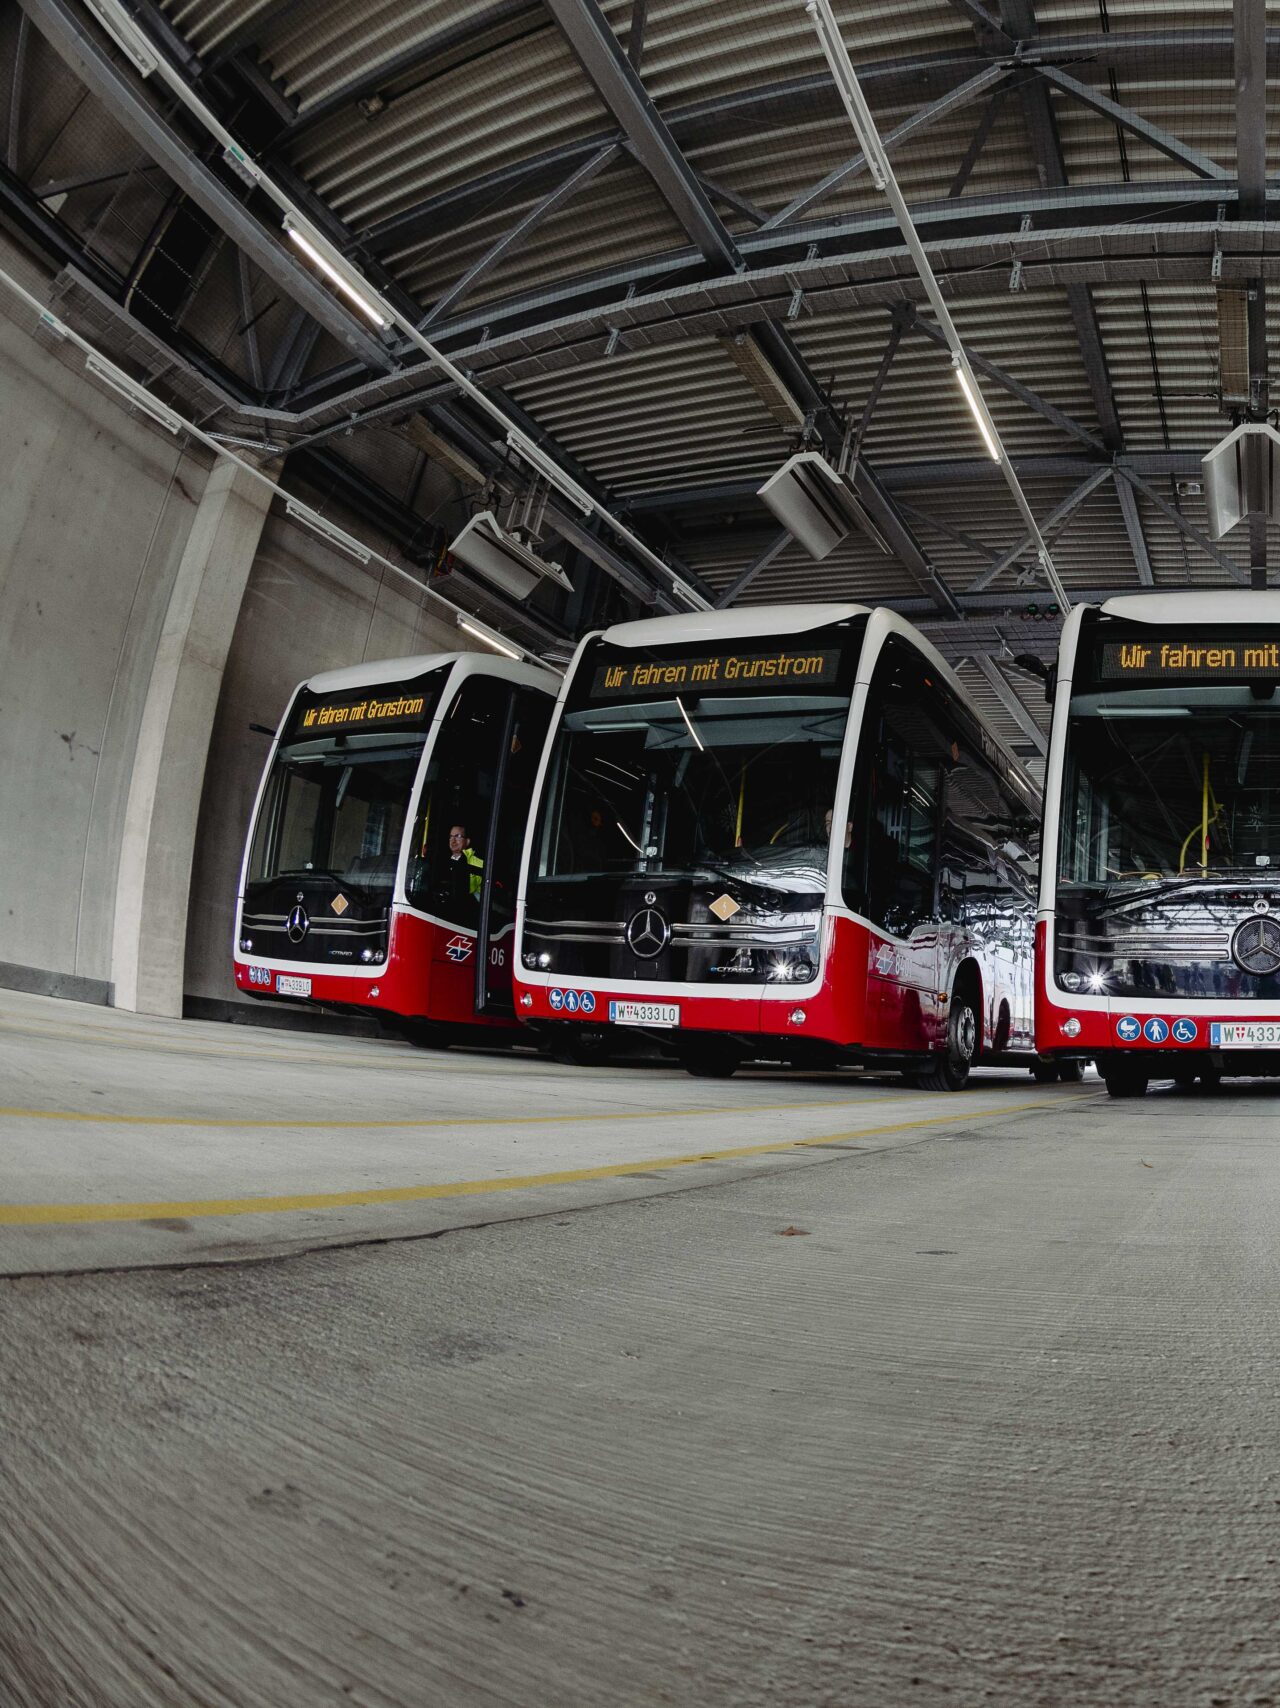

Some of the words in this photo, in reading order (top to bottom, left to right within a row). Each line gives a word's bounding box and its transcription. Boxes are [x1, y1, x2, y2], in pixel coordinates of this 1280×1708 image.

[1121, 645, 1151, 668] Wir
[1160, 645, 1235, 668] fahren
[1244, 645, 1279, 668] mit
[605, 666, 627, 688] Wir
[632, 665, 686, 685] fahren
[691, 660, 720, 681] mit
[304, 709, 317, 727] Wir
[318, 707, 349, 725] fahren
[349, 702, 367, 720] mit
